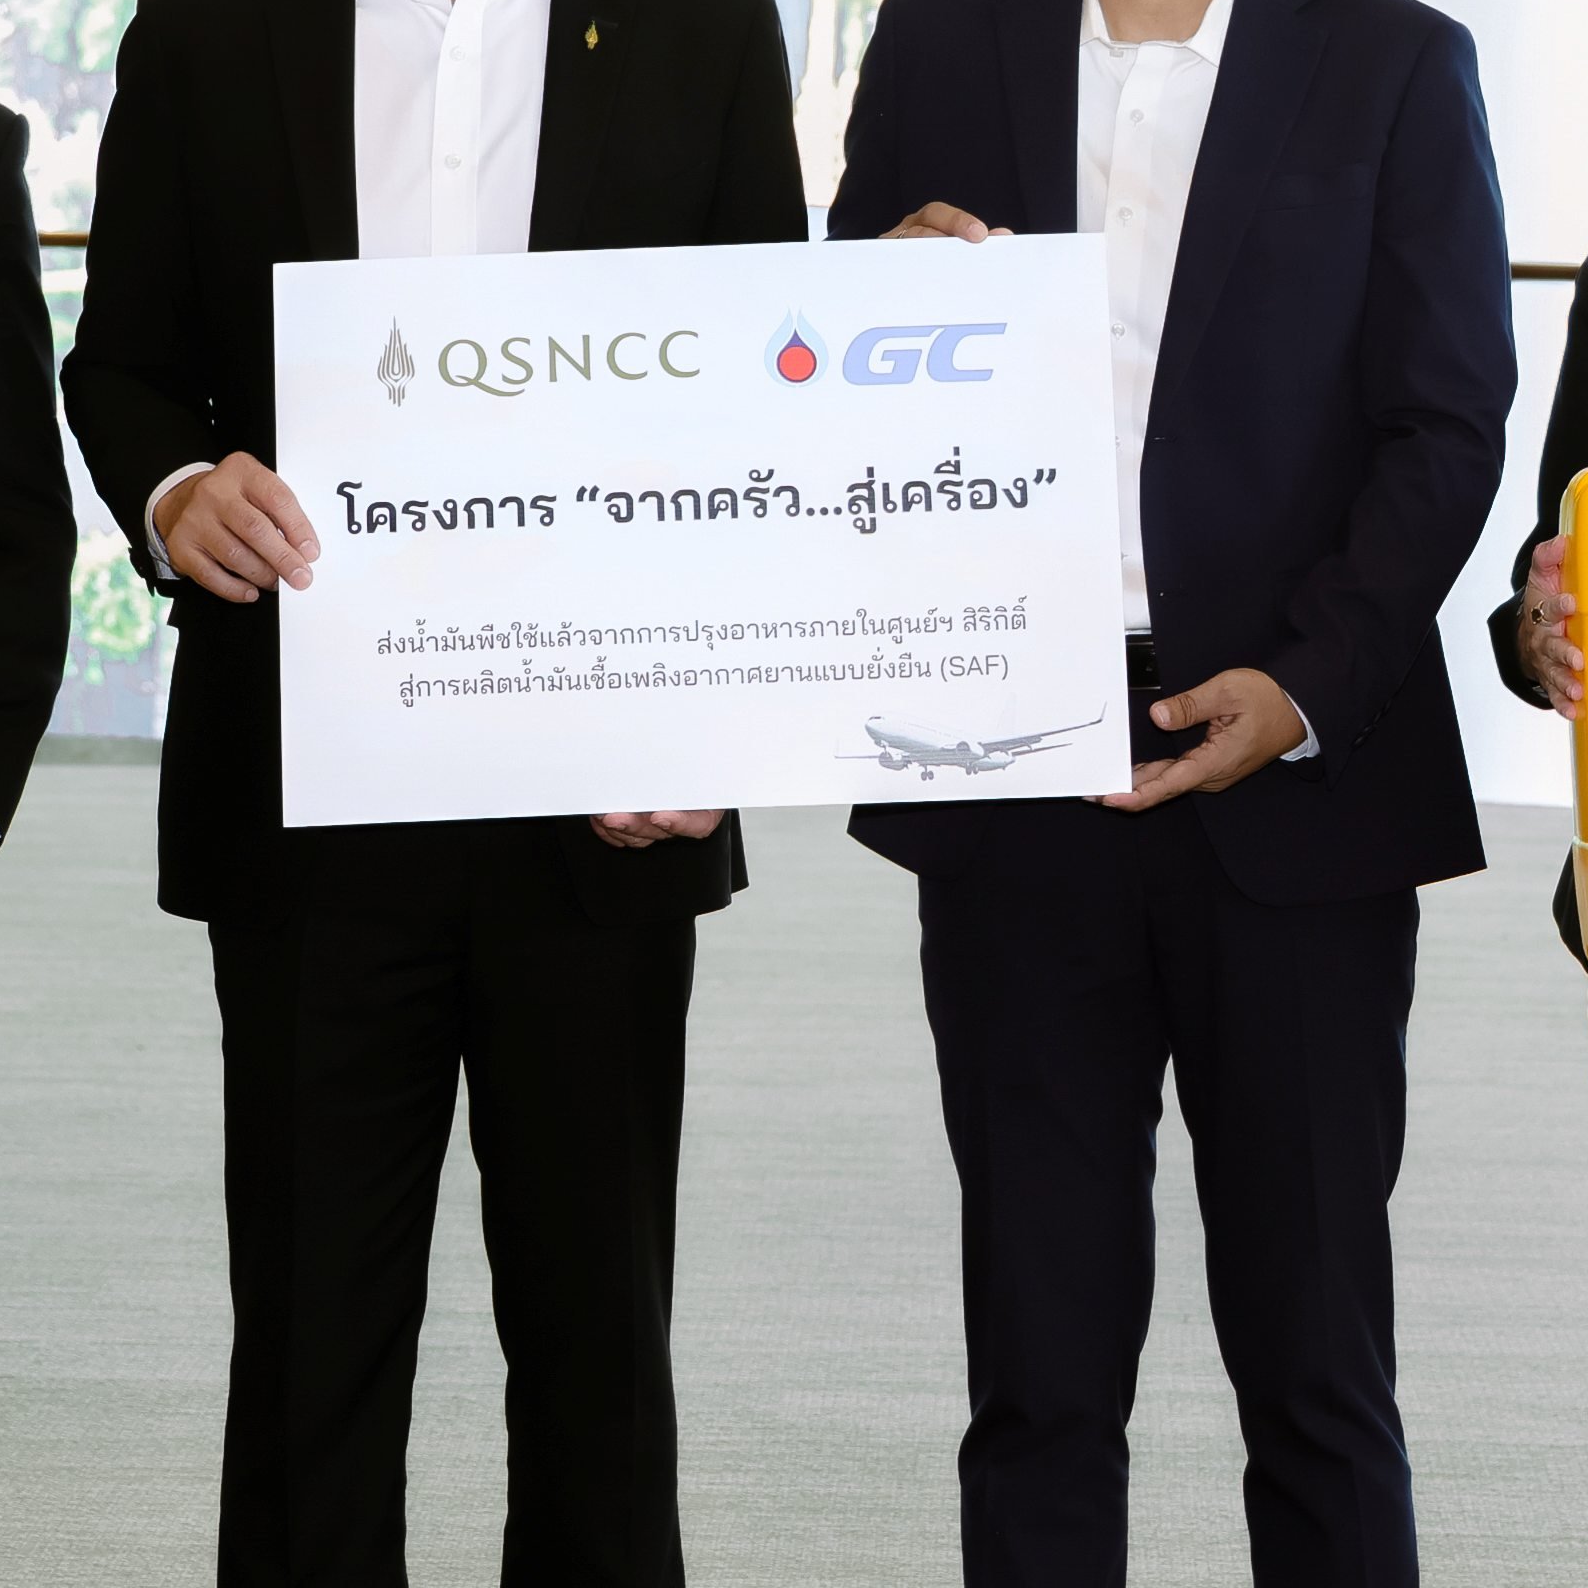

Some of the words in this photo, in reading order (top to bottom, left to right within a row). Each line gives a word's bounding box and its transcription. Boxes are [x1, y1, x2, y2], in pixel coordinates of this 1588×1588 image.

[438, 330, 700, 398] QSNCC
[842, 322, 1008, 386] GC
[336, 480, 557, 535] โครงการ
[962, 594, 1028, 633] สิริกิติ์
[398, 646, 932, 708] สู่การผลิตน้ำมันเชื้อเพลิงอากาศยานแบบยั่งยืน
[939, 654, 1010, 683] (SAF)
